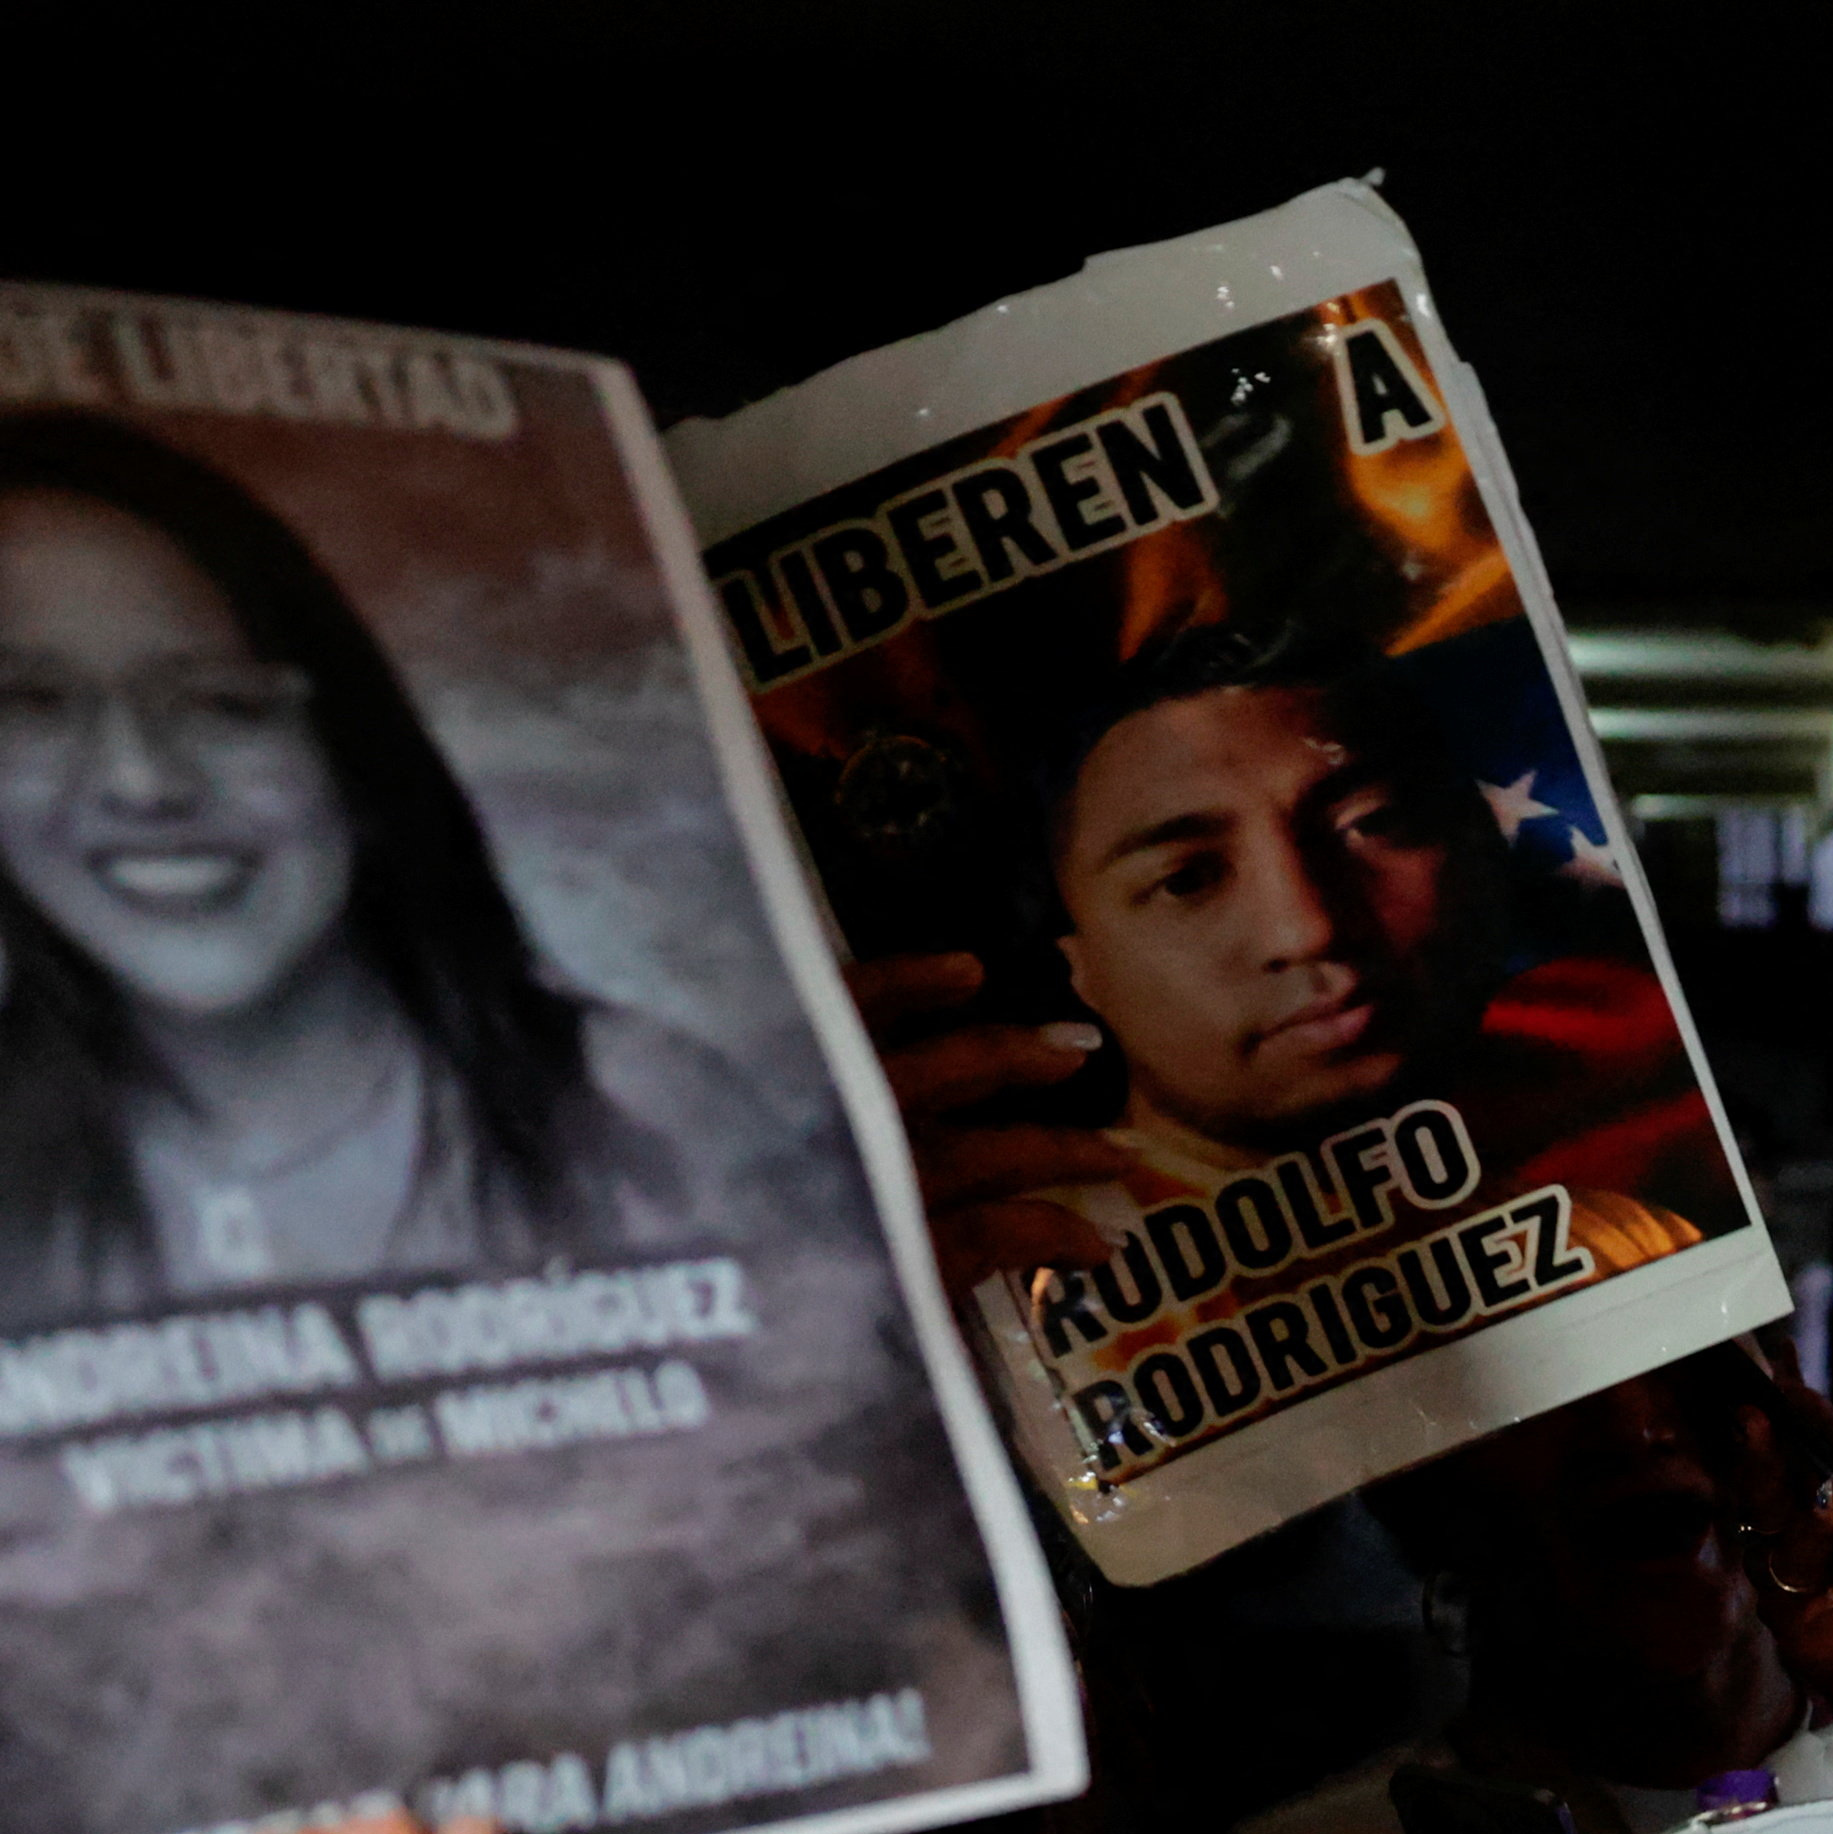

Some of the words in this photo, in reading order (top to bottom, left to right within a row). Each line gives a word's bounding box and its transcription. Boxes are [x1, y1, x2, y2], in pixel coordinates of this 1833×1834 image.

[110, 308, 518, 440] LIBERTAD
[717, 396, 1216, 690] LIBEREN
[1337, 323, 1444, 451] A
[0, 1298, 360, 1438] NDREINA
[1070, 1194, 1586, 1472] RODRIGUEZ
